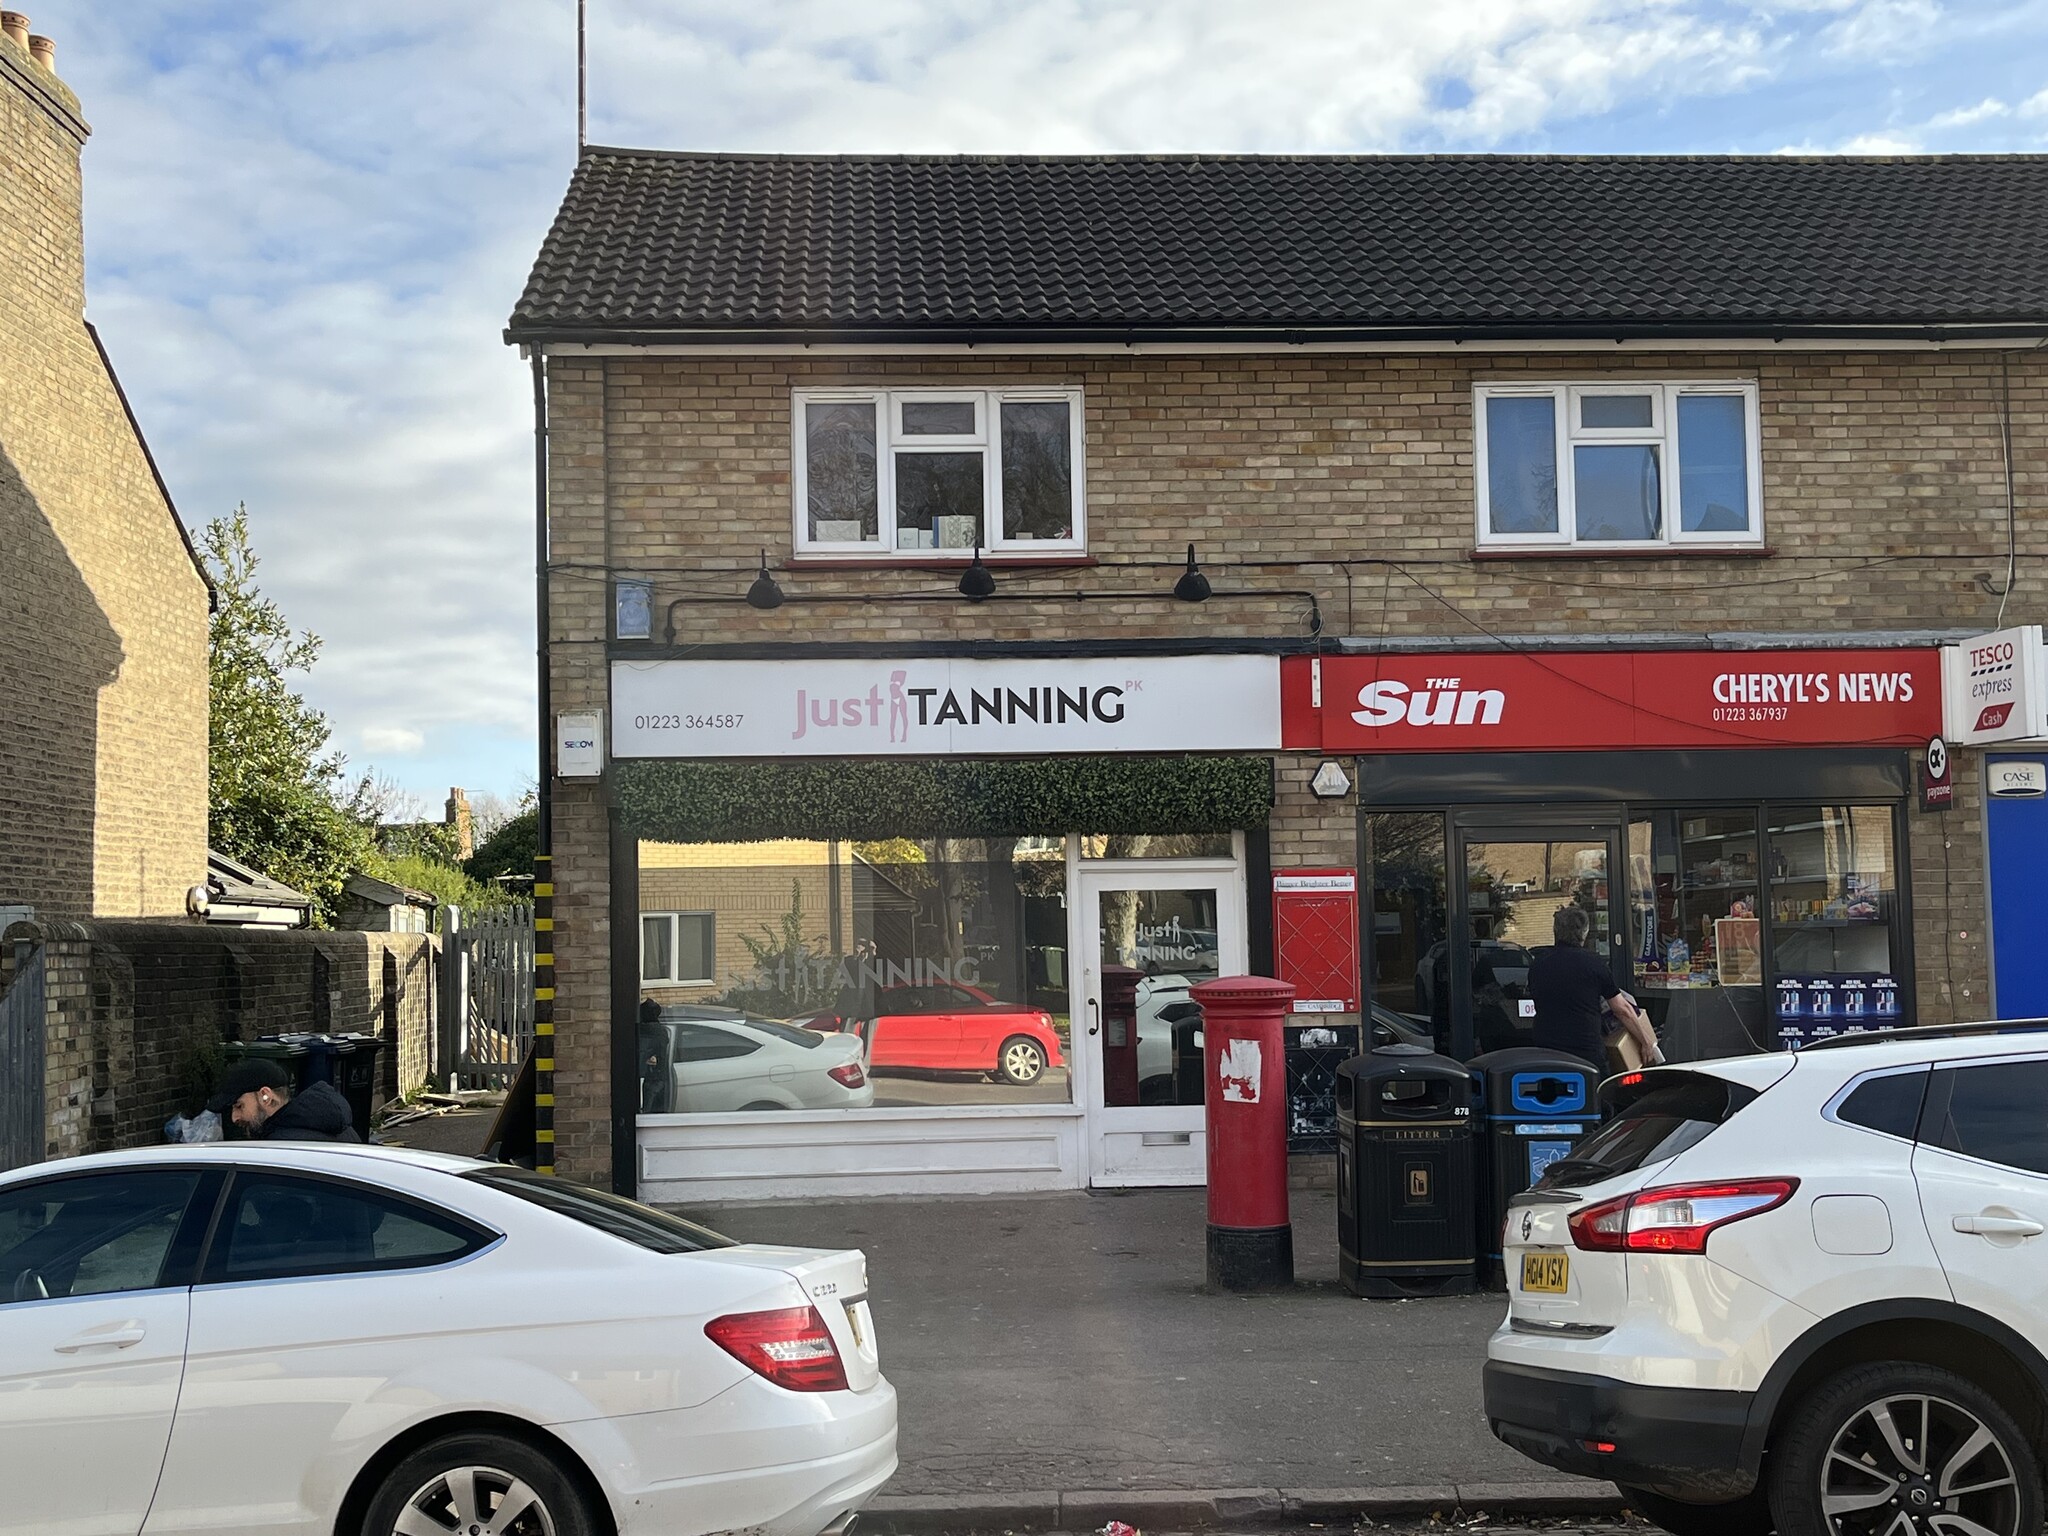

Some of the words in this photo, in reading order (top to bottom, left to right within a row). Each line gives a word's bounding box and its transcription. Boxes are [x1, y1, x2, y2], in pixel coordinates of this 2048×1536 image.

[1970, 642, 2013, 668] TESCO
[1426, 677, 1460, 690] THE
[1712, 671, 1830, 705] CHERYL'S
[1838, 670, 1914, 703] NEWS
[1972, 677, 2012, 701] express
[791, 683, 881, 741] Just
[908, 685, 1125, 727] TANNING
[1125, 680, 1143, 693] PK
[1351, 681, 1506, 727] Sun
[634, 714, 680, 730] 01223
[684, 713, 744, 730] 364587
[1712, 707, 1746, 722] 01223
[1749, 707, 1788, 722] 367937
[1982, 711, 2003, 727] Cash
[564, 740, 594, 749] SECOM
[2003, 771, 2035, 782] CASE
[1927, 785, 1951, 801] payzone
[1138, 920, 1172, 942] Just
[1116, 945, 1196, 961] TANNING
[813, 956, 980, 990] TANNING
[980, 951, 995, 962] PK
[1454, 1107, 1470, 1116] 878
[1395, 1131, 1440, 1139] LITTER
[1526, 1256, 1543, 1286] HG14
[1546, 1257, 1564, 1287] YSX
